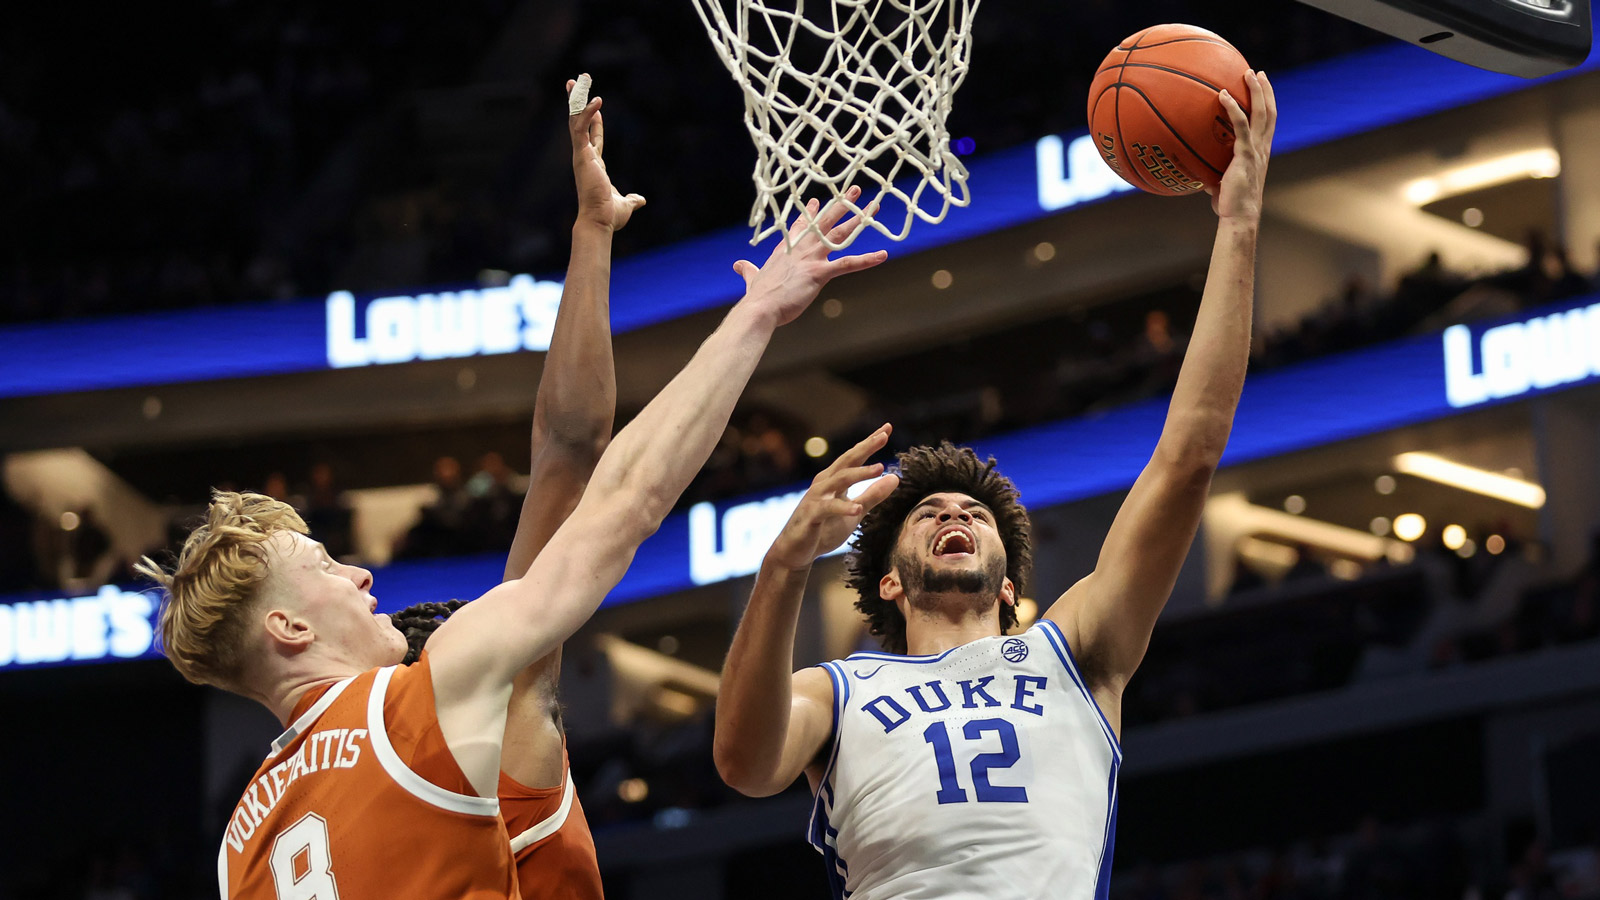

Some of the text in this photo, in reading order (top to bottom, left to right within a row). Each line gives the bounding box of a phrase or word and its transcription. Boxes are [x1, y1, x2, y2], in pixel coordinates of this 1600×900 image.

[1131, 142, 1190, 193] EGACY
[325, 273, 566, 369] LOWE'S
[0, 584, 154, 666] WE'S
[861, 675, 1048, 734] DUKE
[923, 718, 1029, 805] 12
[268, 811, 340, 900] 8
